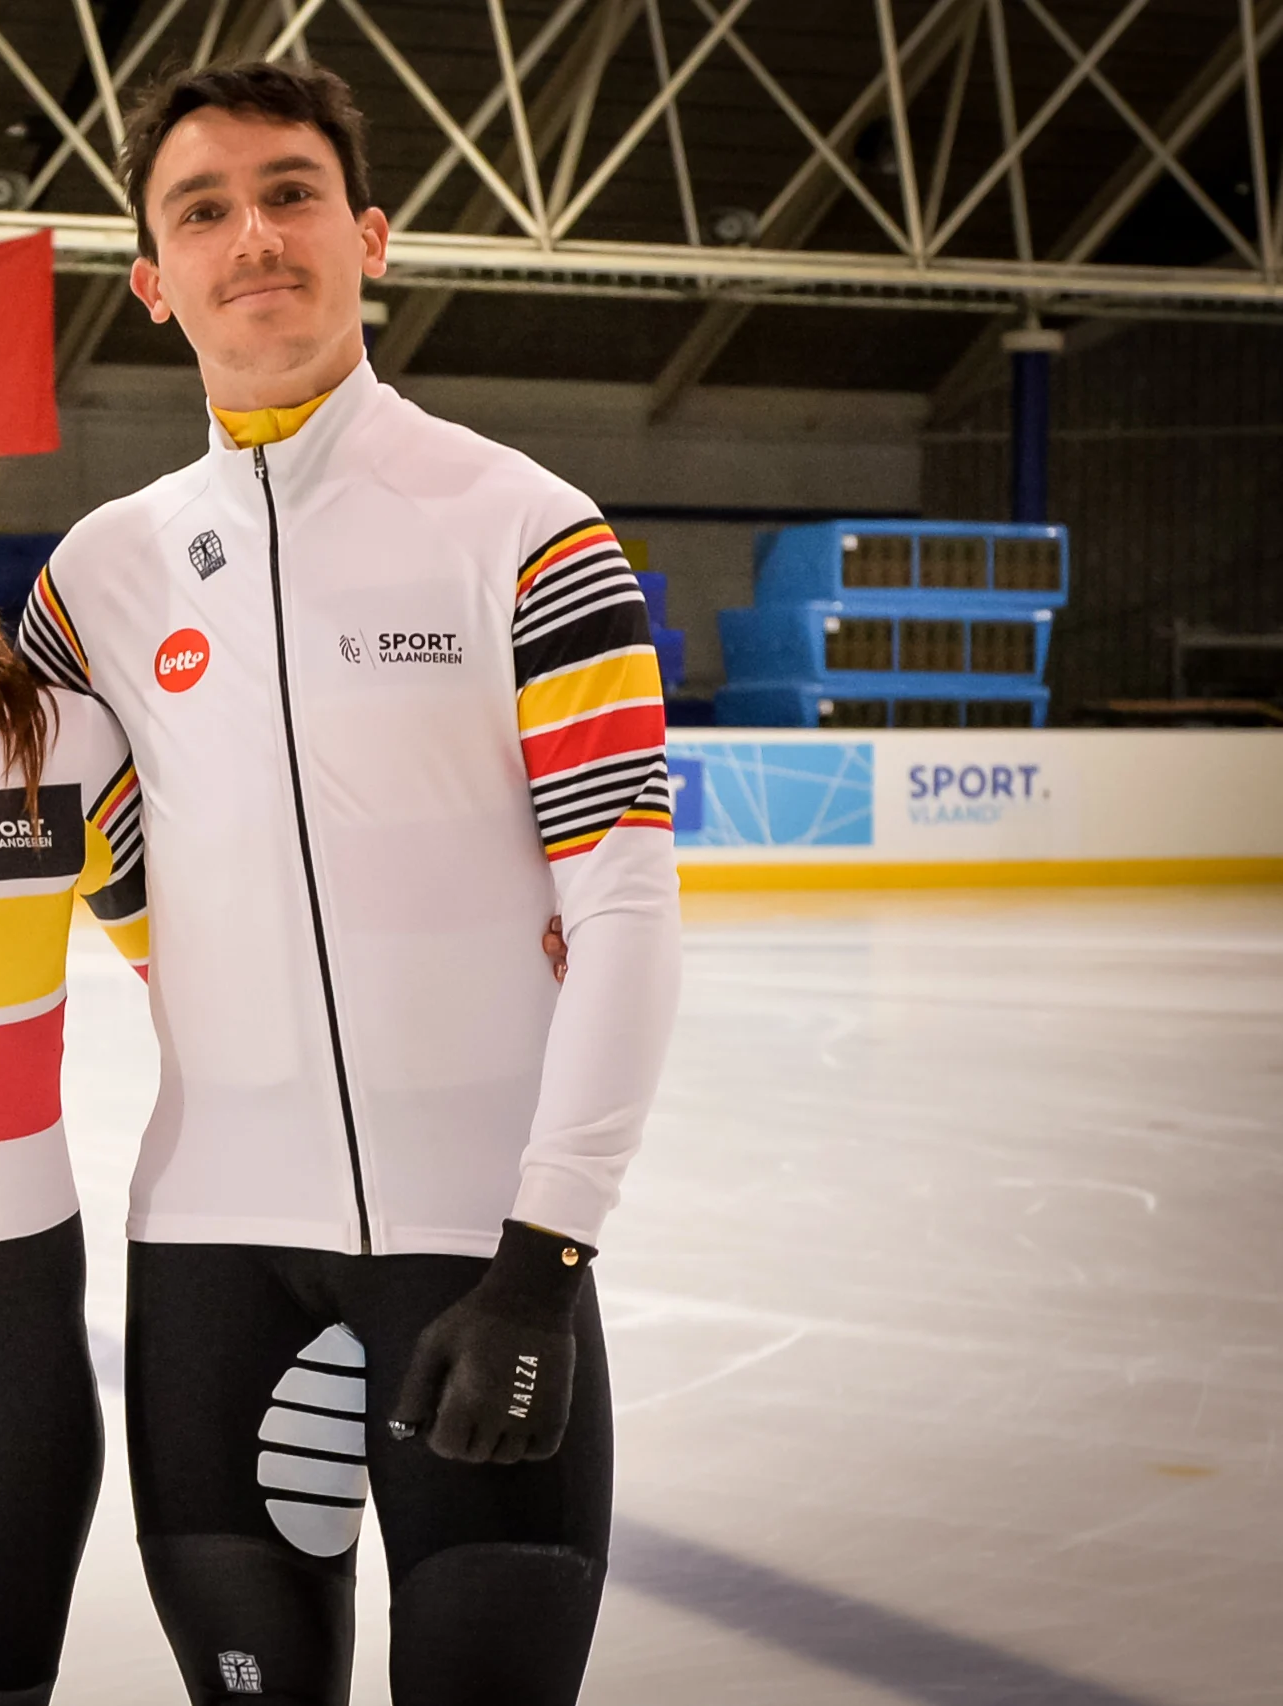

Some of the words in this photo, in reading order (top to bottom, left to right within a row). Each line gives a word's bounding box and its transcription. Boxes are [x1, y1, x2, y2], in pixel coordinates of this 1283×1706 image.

[378, 633, 463, 653] SPORT.
[158, 650, 205, 676] Lotto
[378, 650, 463, 665] VLAANDEREN
